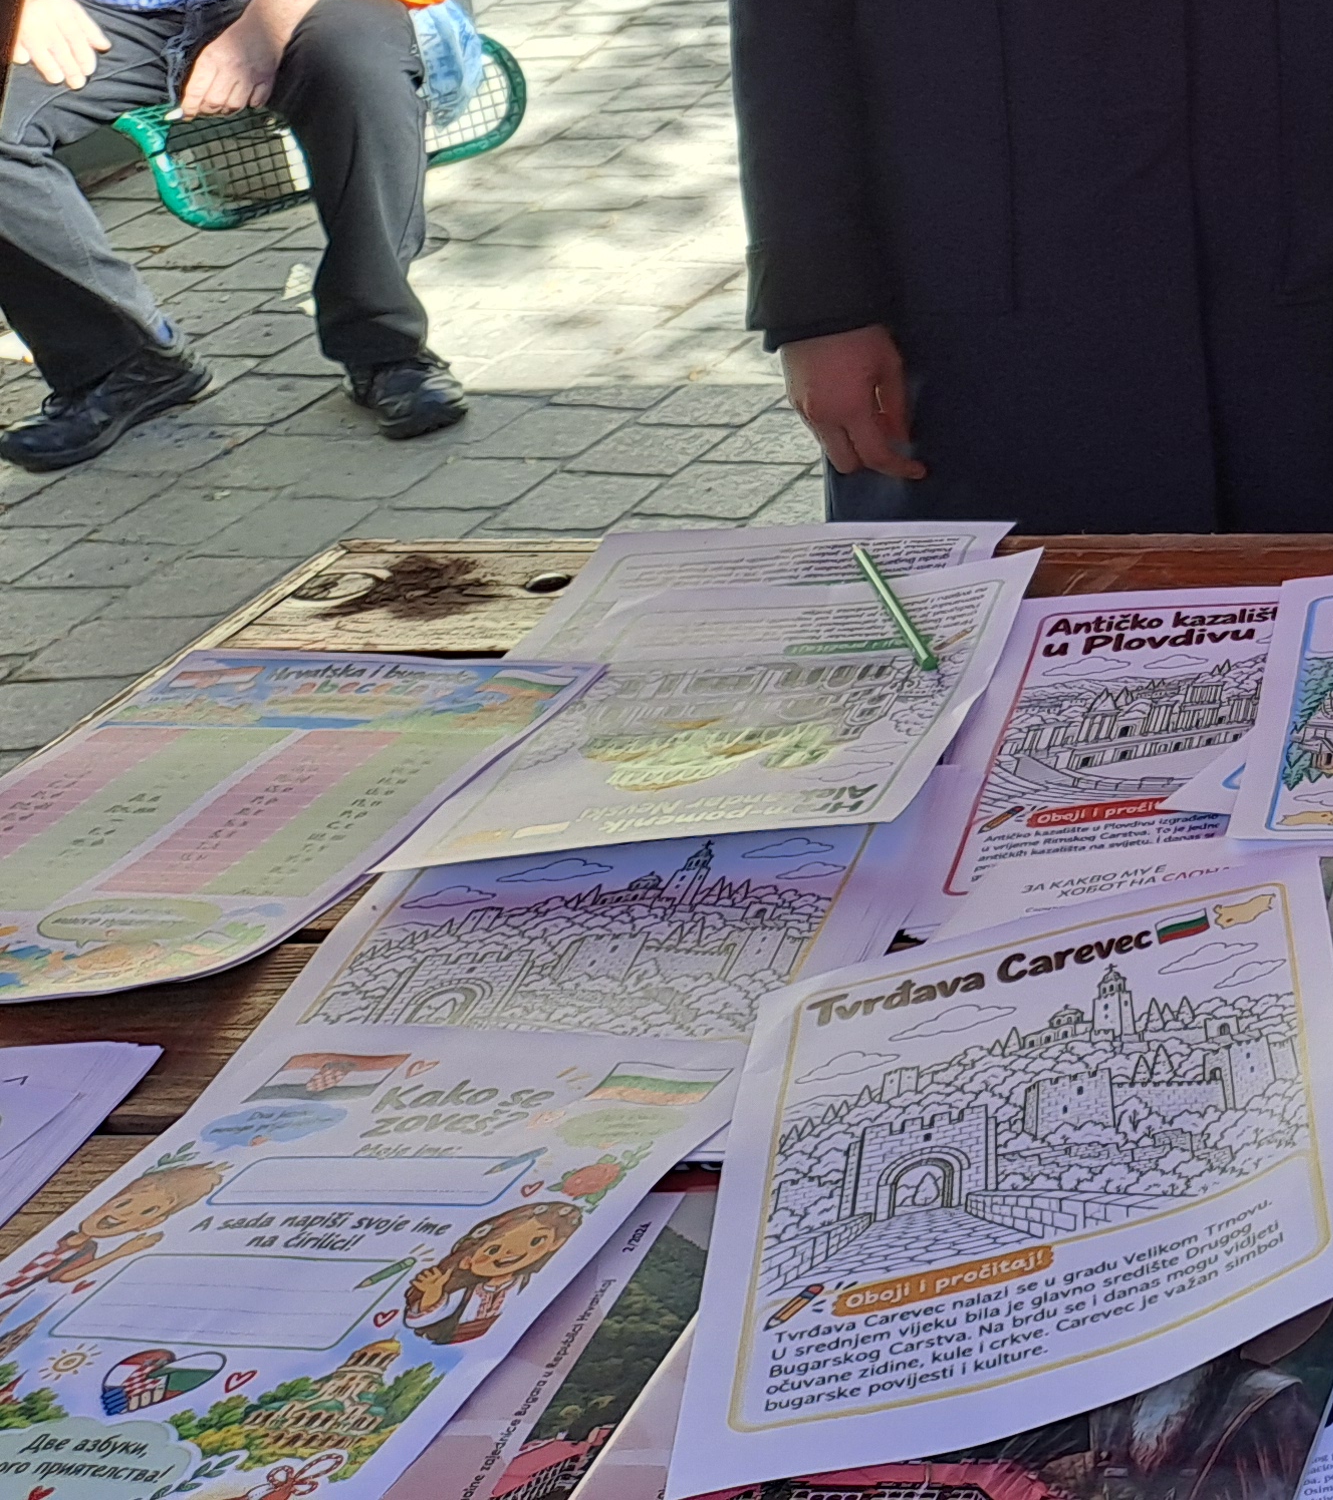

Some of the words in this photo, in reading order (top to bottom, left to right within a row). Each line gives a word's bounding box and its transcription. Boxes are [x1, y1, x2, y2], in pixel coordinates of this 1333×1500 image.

[1045, 613, 1163, 637] Antičko
[1042, 641, 1069, 657] u
[1081, 628, 1256, 656] Plovdivu
[1037, 808, 1086, 823] Oboji
[983, 832, 1031, 842] Antičko
[993, 840, 1040, 851] vrijeme
[1021, 882, 1045, 894] ЗА
[1049, 872, 1118, 891] КАКВО
[1120, 866, 1153, 880] МУ
[1056, 880, 1127, 899] ХОБОТ
[1128, 875, 1156, 887] НА
[805, 971, 985, 1027] Tvrđava
[996, 930, 1153, 983] Carevec
[371, 1079, 499, 1114] Kako
[497, 1088, 555, 1109] se
[359, 1107, 530, 1139] zoveš?
[188, 1215, 215, 1232] A
[217, 1211, 273, 1231] sada
[279, 1211, 355, 1233] napiši
[351, 1214, 409, 1236] svoje
[410, 1216, 454, 1237] ime
[246, 1234, 280, 1248] na
[774, 1320, 857, 1344] Tvrđava
[864, 1302, 946, 1328] Carevec
[951, 1286, 1009, 1311] nalazi
[1015, 1281, 1039, 1295] se
[1043, 1276, 1056, 1287] u
[1062, 1260, 1119, 1285] gradu
[1122, 1234, 1199, 1267] Velikom
[1204, 1199, 1275, 1237] Trnovu.
[845, 1284, 911, 1309] Oboji
[919, 1280, 927, 1292] i
[934, 1249, 1045, 1292] pročitaj!
[769, 1348, 882, 1378] Bugarskog
[888, 1331, 973, 1356] Carstva.
[978, 1320, 1005, 1336] Na
[1011, 1307, 1058, 1329] brdu
[1064, 1299, 1086, 1315] se
[1103, 1280, 1161, 1303] danas
[1165, 1254, 1219, 1283] mogu
[1223, 1220, 1280, 1257] vidjeti
[770, 1347, 786, 1362] U
[795, 1330, 892, 1358] srednjem
[898, 1314, 958, 1338] vijeku
[964, 1304, 1001, 1324] bila
[1004, 1297, 1025, 1318] je
[1031, 1282, 1096, 1309] glavno
[1102, 1256, 1180, 1288] središte
[1186, 1223, 1253, 1261] Drugog
[765, 1371, 852, 1396] očuvane
[857, 1358, 926, 1381] zidine,
[931, 1343, 974, 1364] kule
[988, 1327, 1051, 1351] crkve.
[1056, 1301, 1136, 1333] Carevec
[1138, 1293, 1159, 1312] je
[1163, 1269, 1219, 1299] važan
[1224, 1231, 1285, 1273] simbol
[764, 1386, 862, 1412] bugarske
[867, 1366, 955, 1396] povijesti
[973, 1345, 1050, 1372] kulture.
[514, 1378, 548, 1417] Bugara
[17, 1433, 72, 1455] Две
[72, 1433, 150, 1460] азбуки,
[32, 1460, 176, 1484] приятелства!
